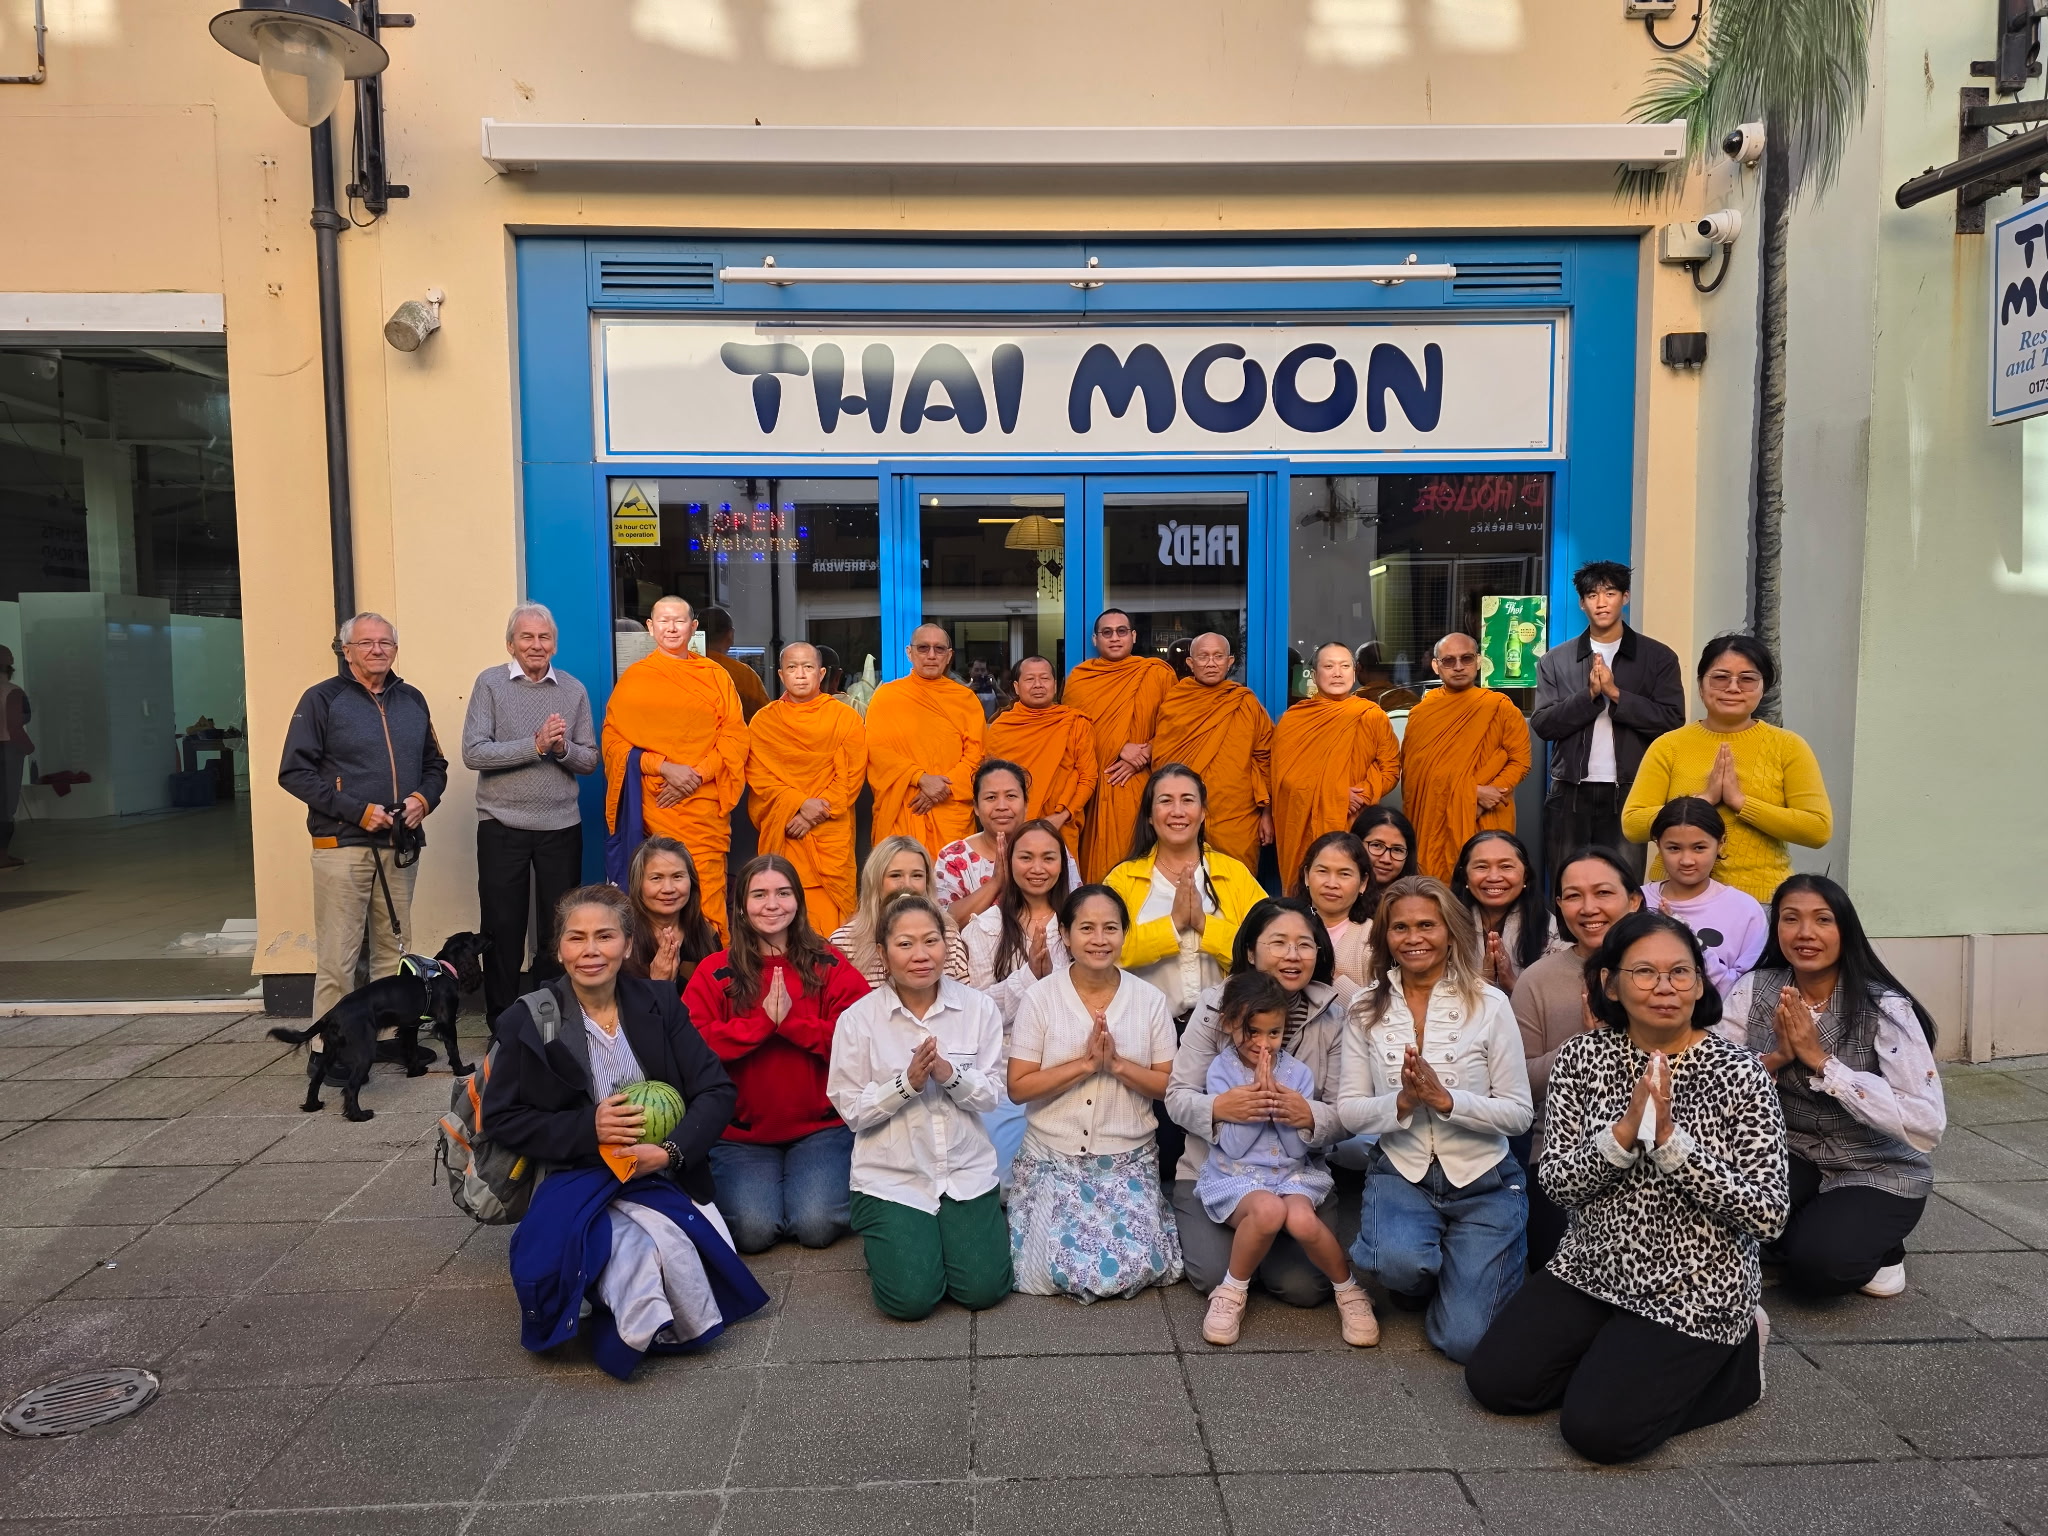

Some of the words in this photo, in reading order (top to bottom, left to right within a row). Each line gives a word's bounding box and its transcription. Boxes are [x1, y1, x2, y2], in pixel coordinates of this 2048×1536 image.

[2015, 219, 2048, 269] T
[2005, 348, 2037, 378] and
[720, 342, 1024, 434] THAI
[1067, 342, 1444, 434] MOON
[712, 511, 786, 531] OPEN
[699, 533, 800, 552] Welcome
